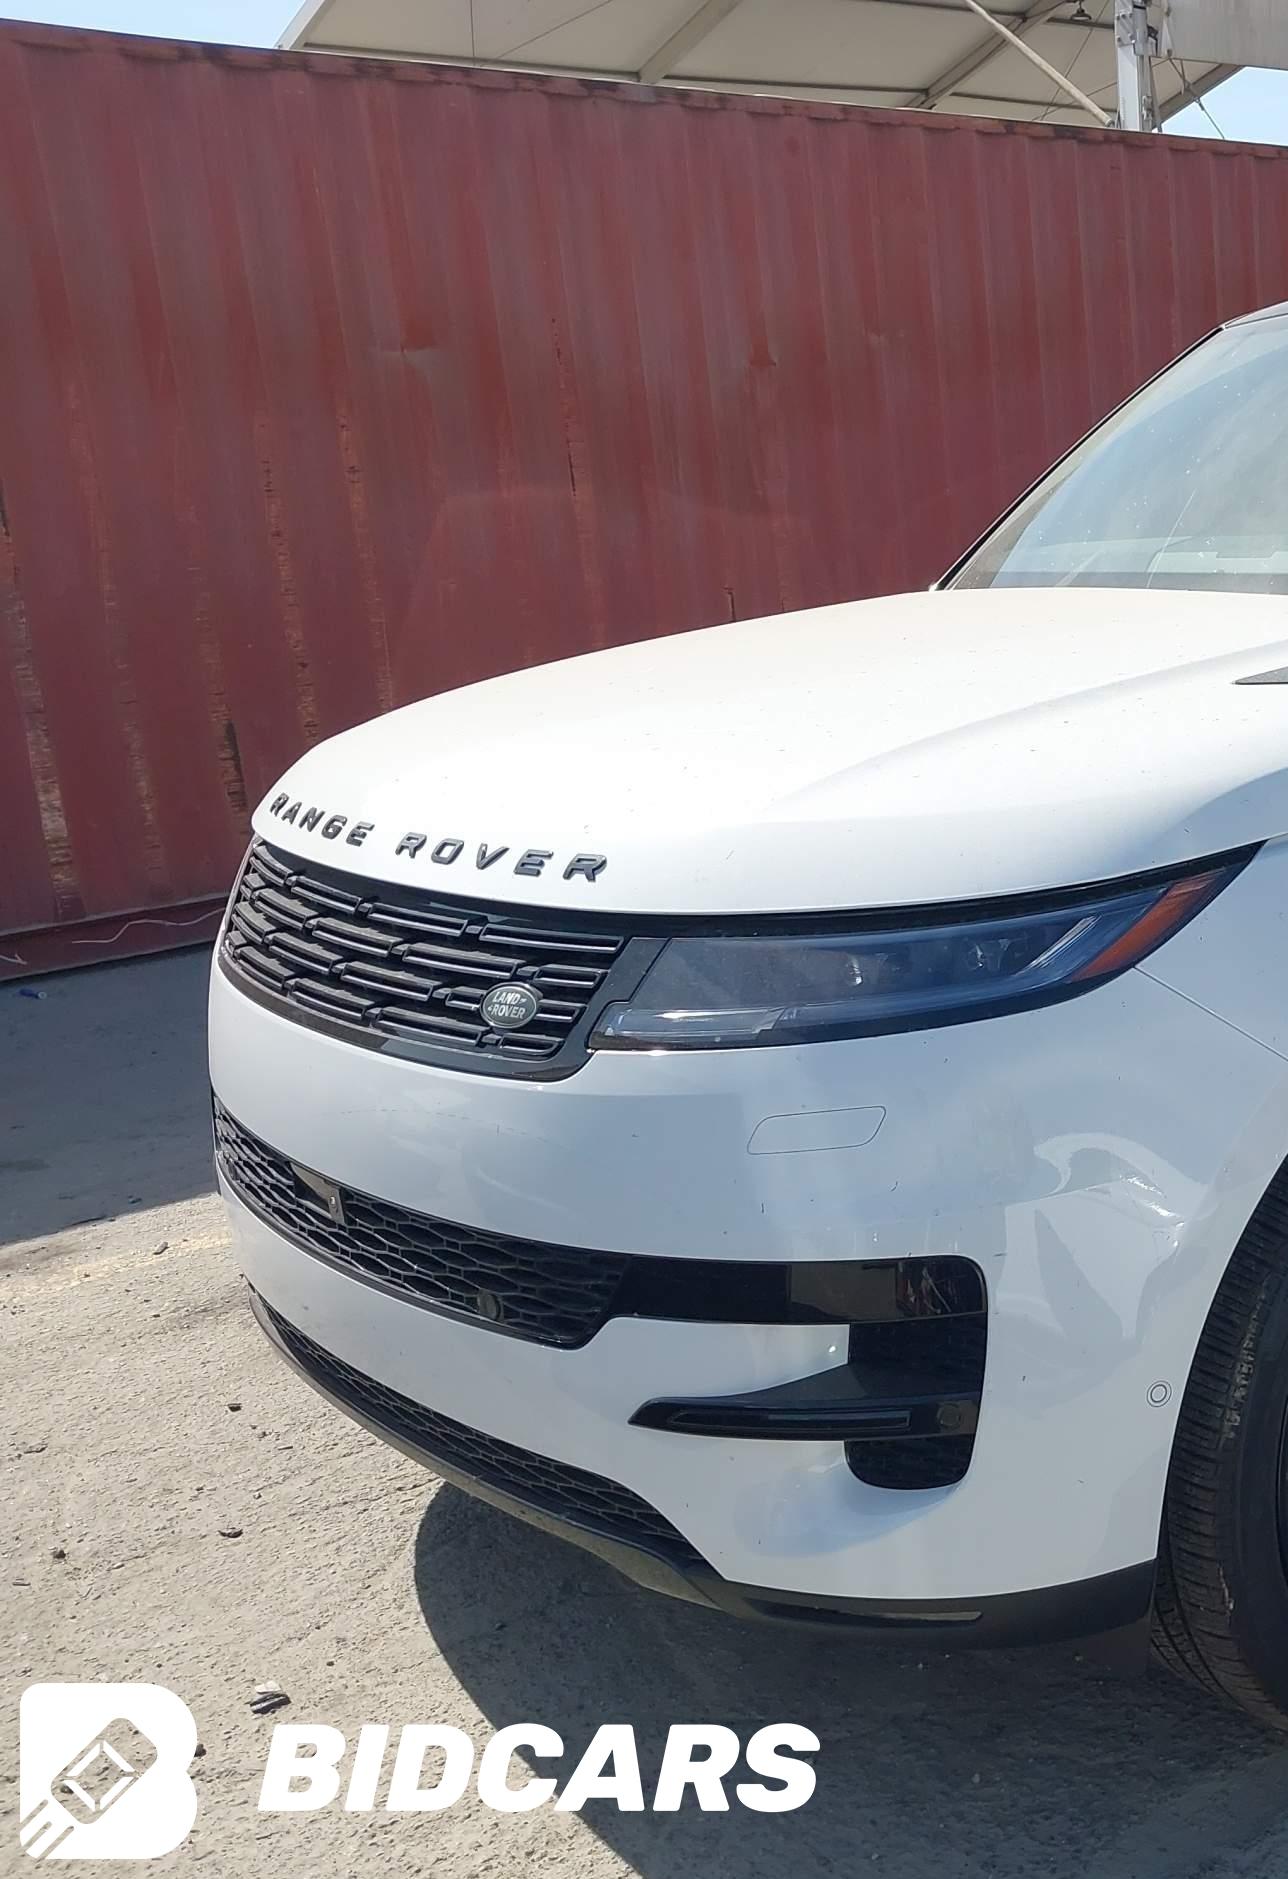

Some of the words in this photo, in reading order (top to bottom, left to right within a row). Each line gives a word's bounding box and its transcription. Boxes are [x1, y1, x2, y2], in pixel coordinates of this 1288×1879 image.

[270, 792, 375, 848] RANGE
[395, 832, 607, 882] ROVER
[492, 991, 521, 1005] LAND
[491, 1004, 526, 1019] ROVER
